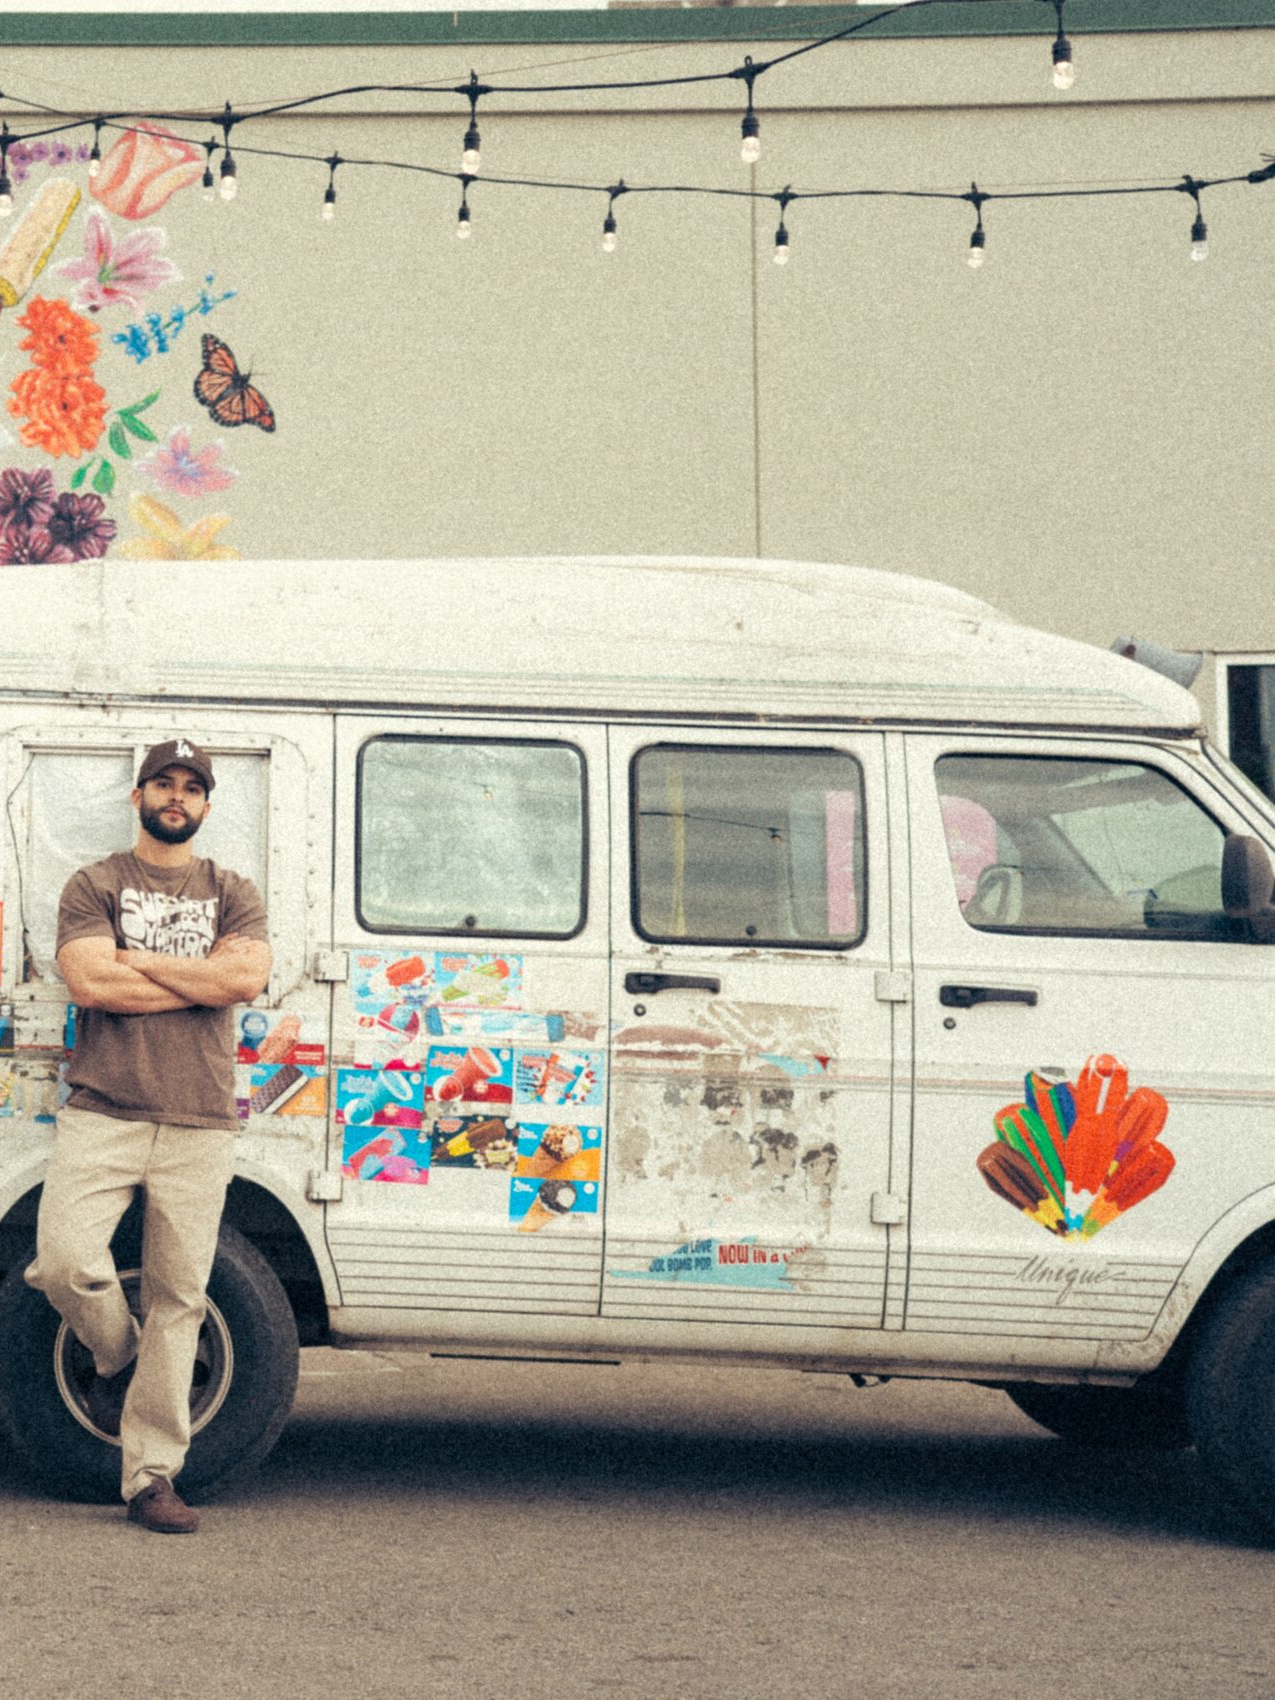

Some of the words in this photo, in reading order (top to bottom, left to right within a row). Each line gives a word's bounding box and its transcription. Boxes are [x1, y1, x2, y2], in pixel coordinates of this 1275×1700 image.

[667, 1256, 693, 1272] BOMB
[718, 1244, 749, 1264] NOW
[1015, 1254, 1126, 1306] Unique
